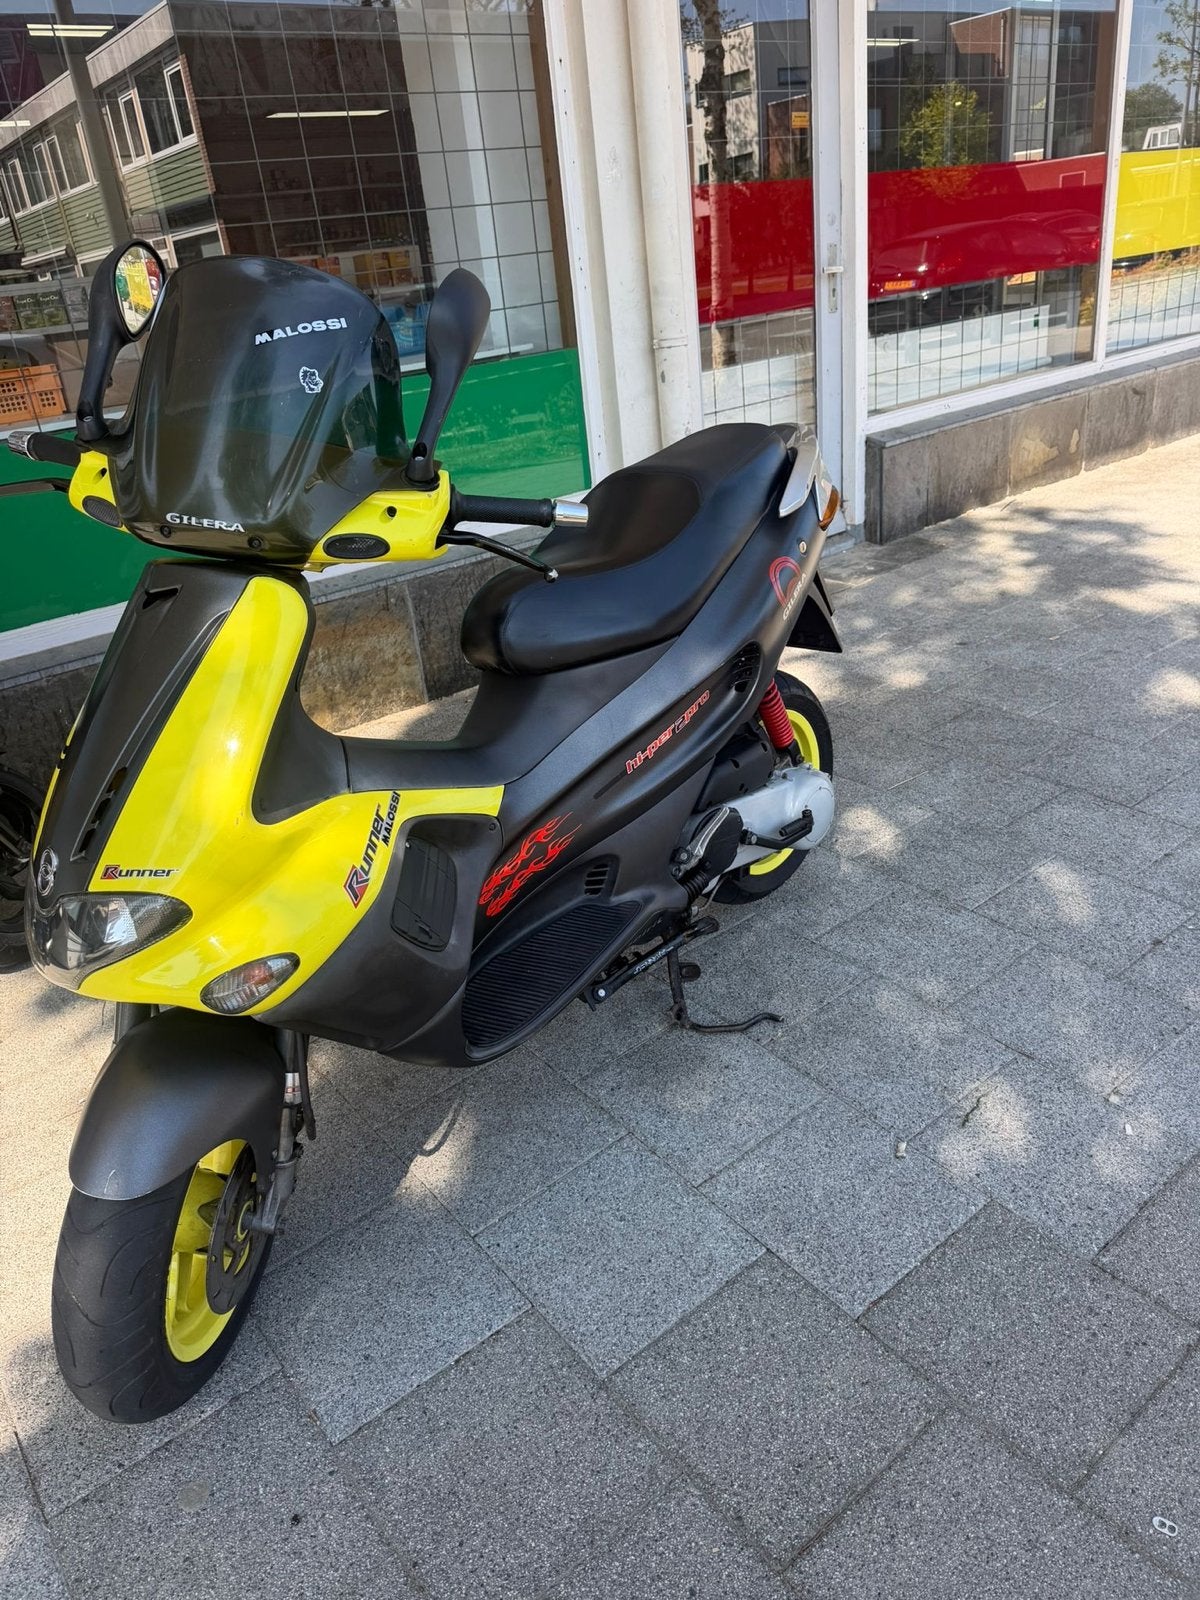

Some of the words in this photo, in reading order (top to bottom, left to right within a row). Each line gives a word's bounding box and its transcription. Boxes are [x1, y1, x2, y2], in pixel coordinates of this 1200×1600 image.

[255, 317, 347, 345] MALOSSI
[165, 512, 246, 532] GILERA
[381, 791, 400, 847] MALOSSI
[342, 803, 384, 909] Runner
[101, 865, 175, 879] Runner
